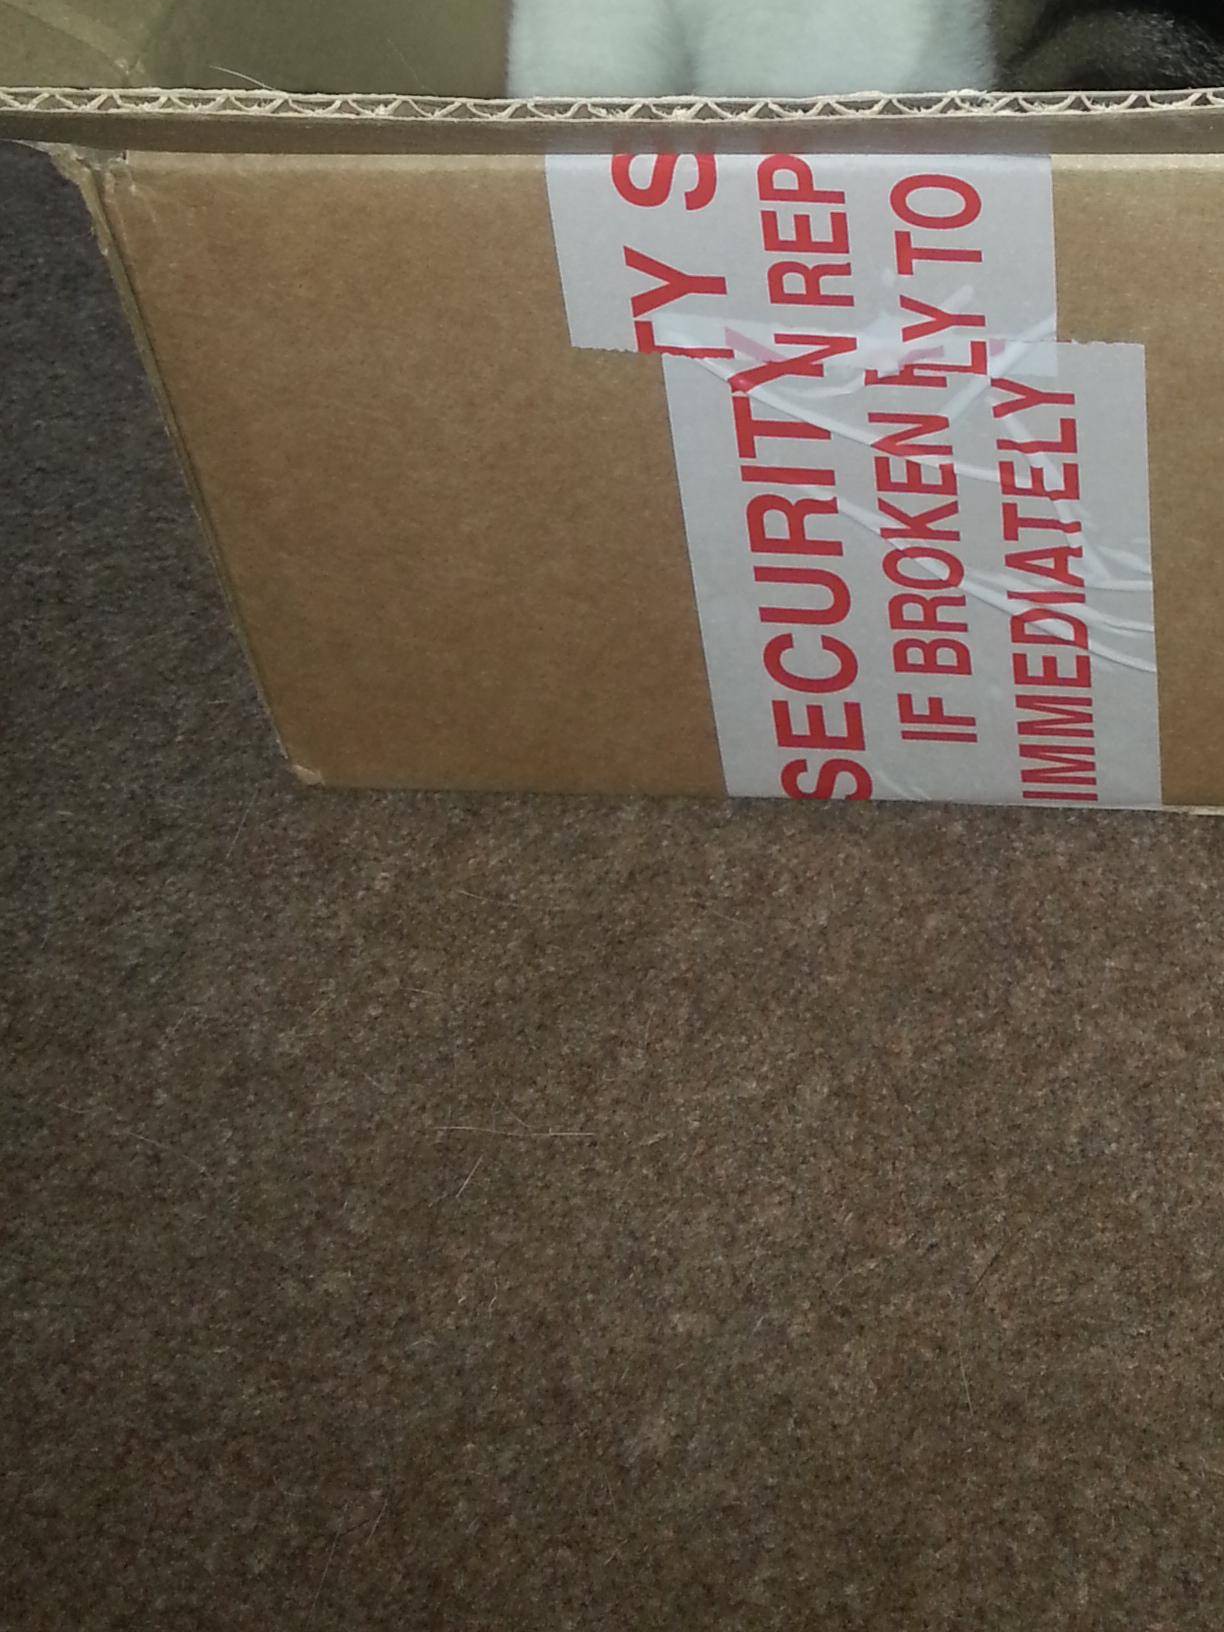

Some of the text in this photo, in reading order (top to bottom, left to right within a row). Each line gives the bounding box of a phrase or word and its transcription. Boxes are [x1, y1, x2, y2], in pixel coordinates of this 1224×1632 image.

[757, 153, 855, 307] REP
[890, 174, 984, 276] TO
[732, 328, 873, 801] SECURITY
[867, 413, 974, 676] BROKEN
[990, 378, 1099, 802] IMMEDIATELY
[897, 693, 978, 744] IF
